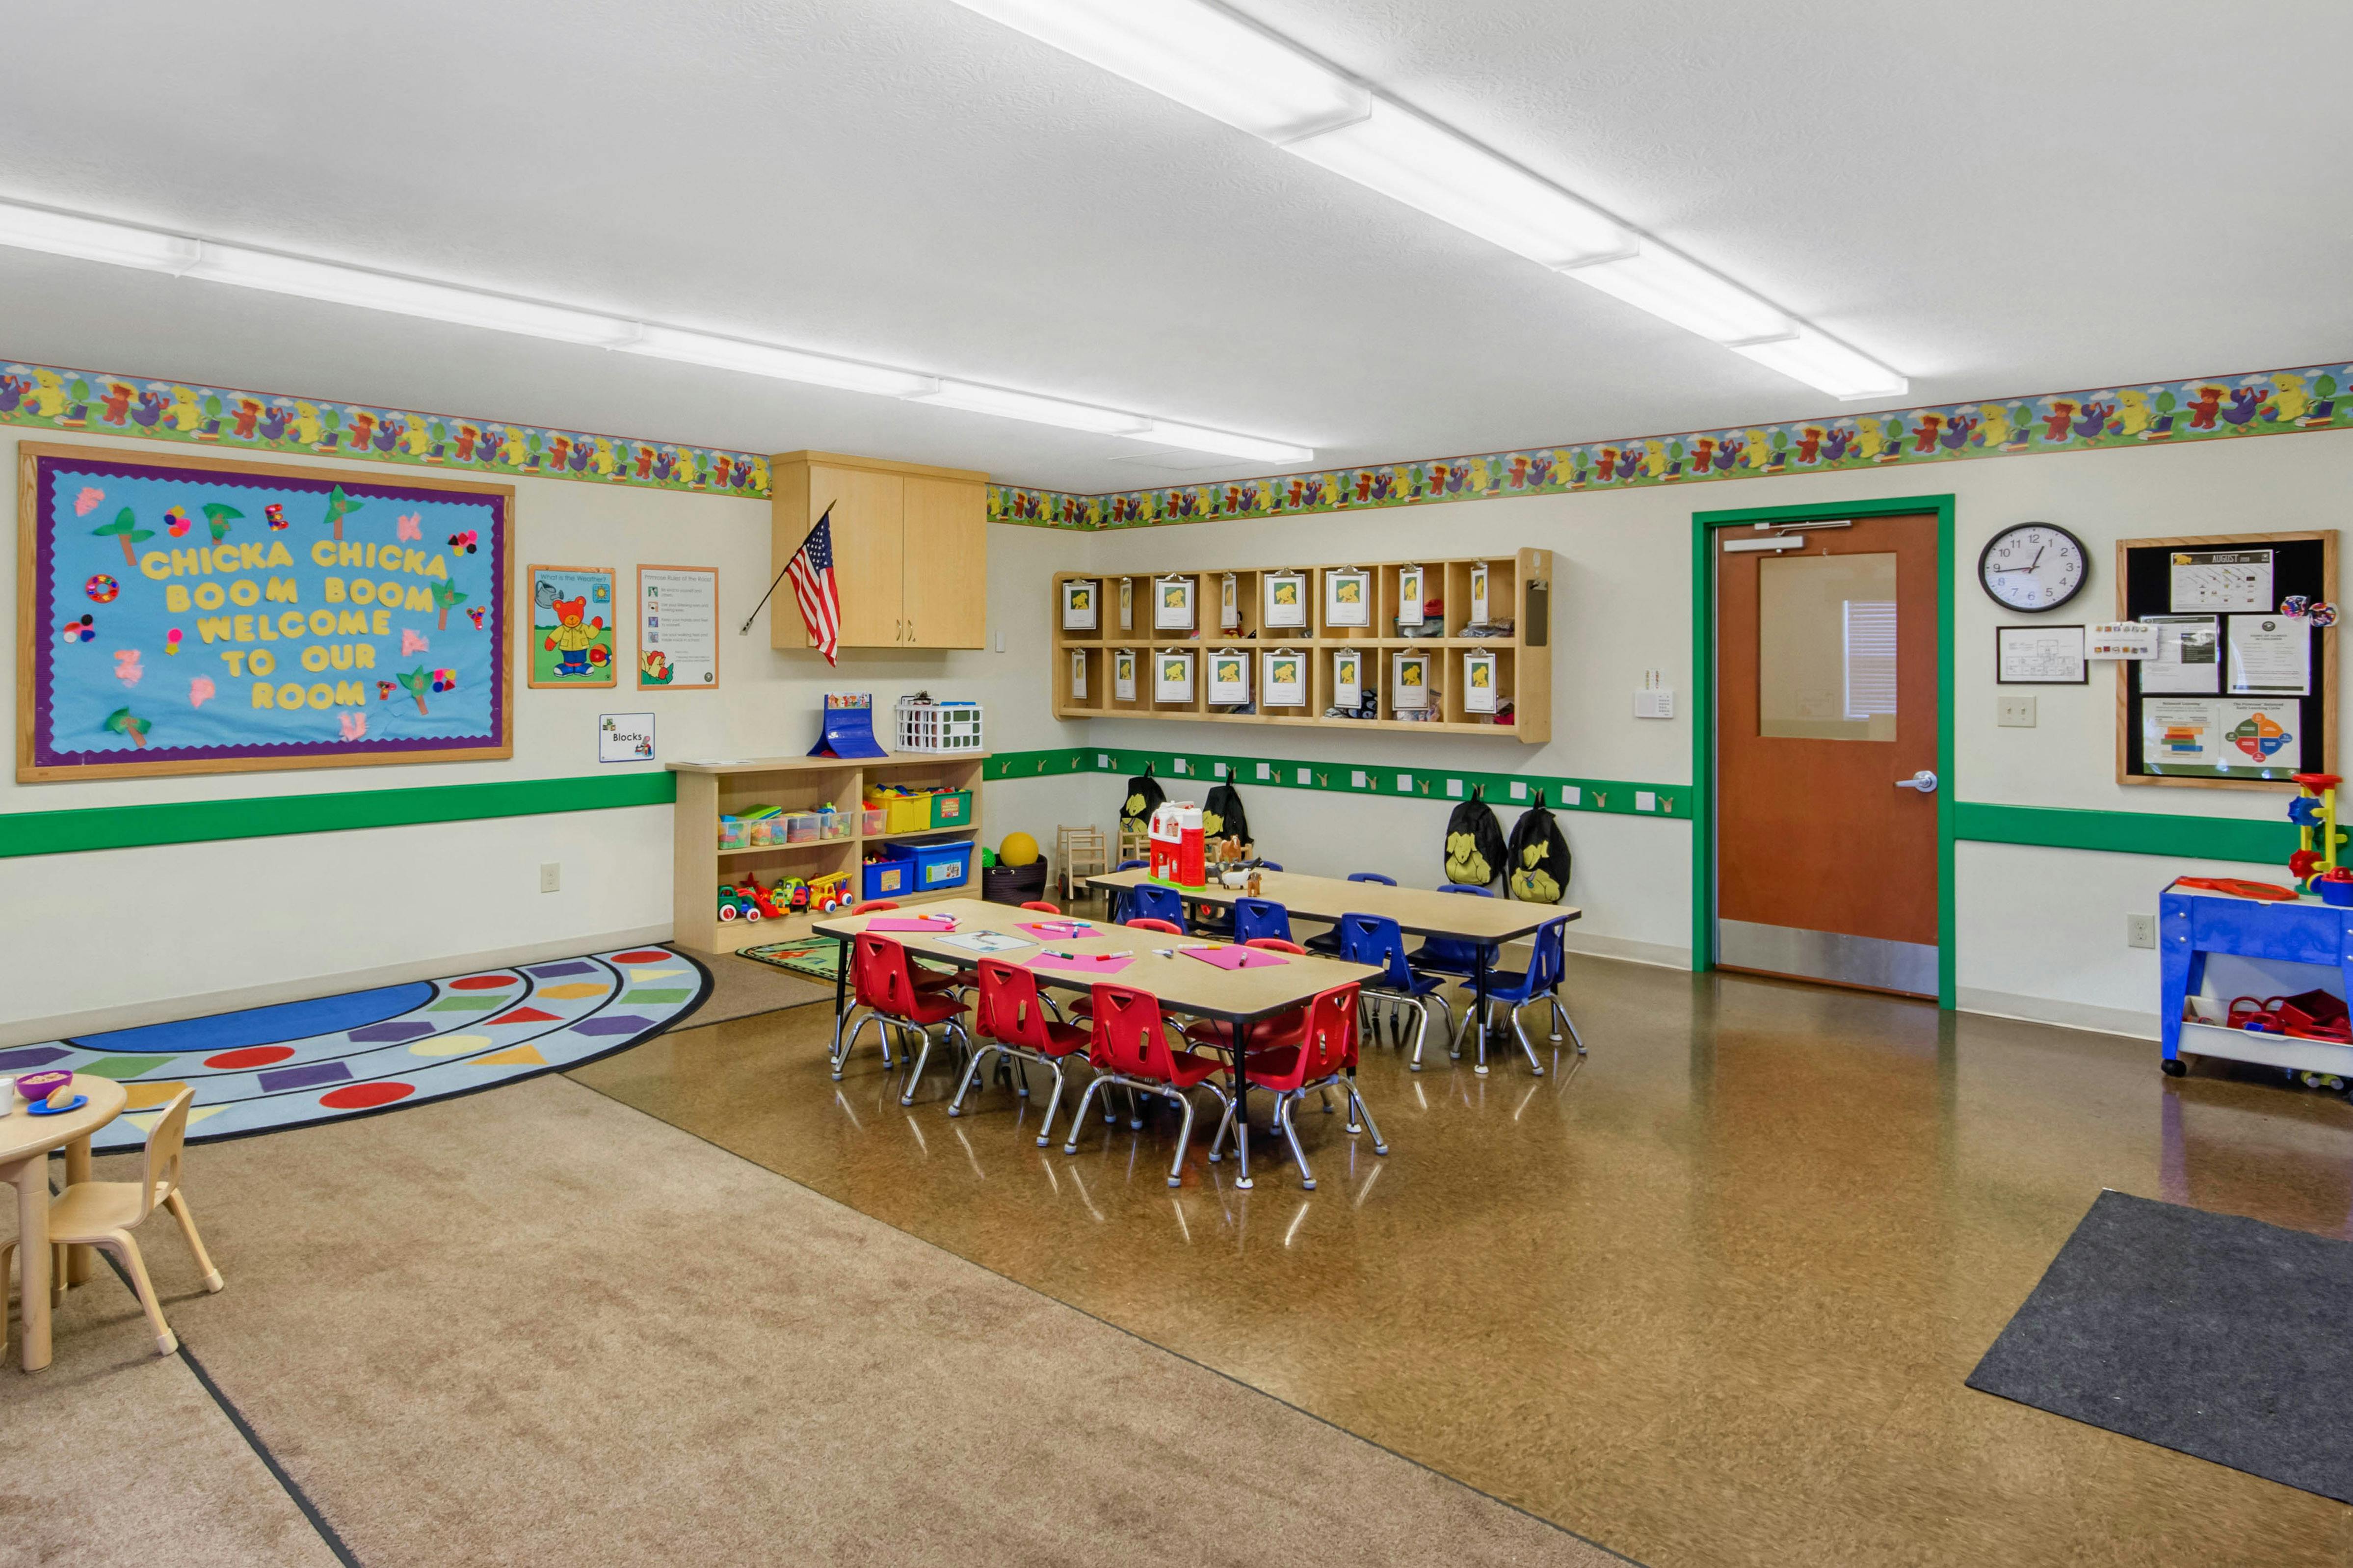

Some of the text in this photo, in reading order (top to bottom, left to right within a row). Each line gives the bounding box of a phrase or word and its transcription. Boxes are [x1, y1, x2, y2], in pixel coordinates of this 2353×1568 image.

[264, 503, 290, 532] E
[2029, 534, 2040, 543] 12
[2048, 539, 2052, 547] 1
[2010, 540, 2020, 548] 11
[1999, 548, 2010, 557] 10
[2061, 548, 2068, 557] 2
[140, 540, 448, 580] CHICKA CHICKA
[2212, 554, 2239, 563] AUGUST
[1993, 564, 2001, 573] 9
[2066, 562, 2074, 572] 3
[1998, 577, 2005, 586] 8
[2059, 577, 2067, 585] 4
[85, 574, 120, 604] O
[2011, 588, 2019, 596] 7
[2046, 587, 2053, 597] 5
[166, 576, 433, 612] BOOM BOOM
[2028, 591, 2036, 600] 6
[466, 606, 486, 631] Y
[197, 609, 391, 644] WELCOME
[221, 643, 376, 677] TO OUR
[376, 680, 397, 700] T
[252, 680, 366, 710] ROOM
[613, 732, 642, 741] Blocks
